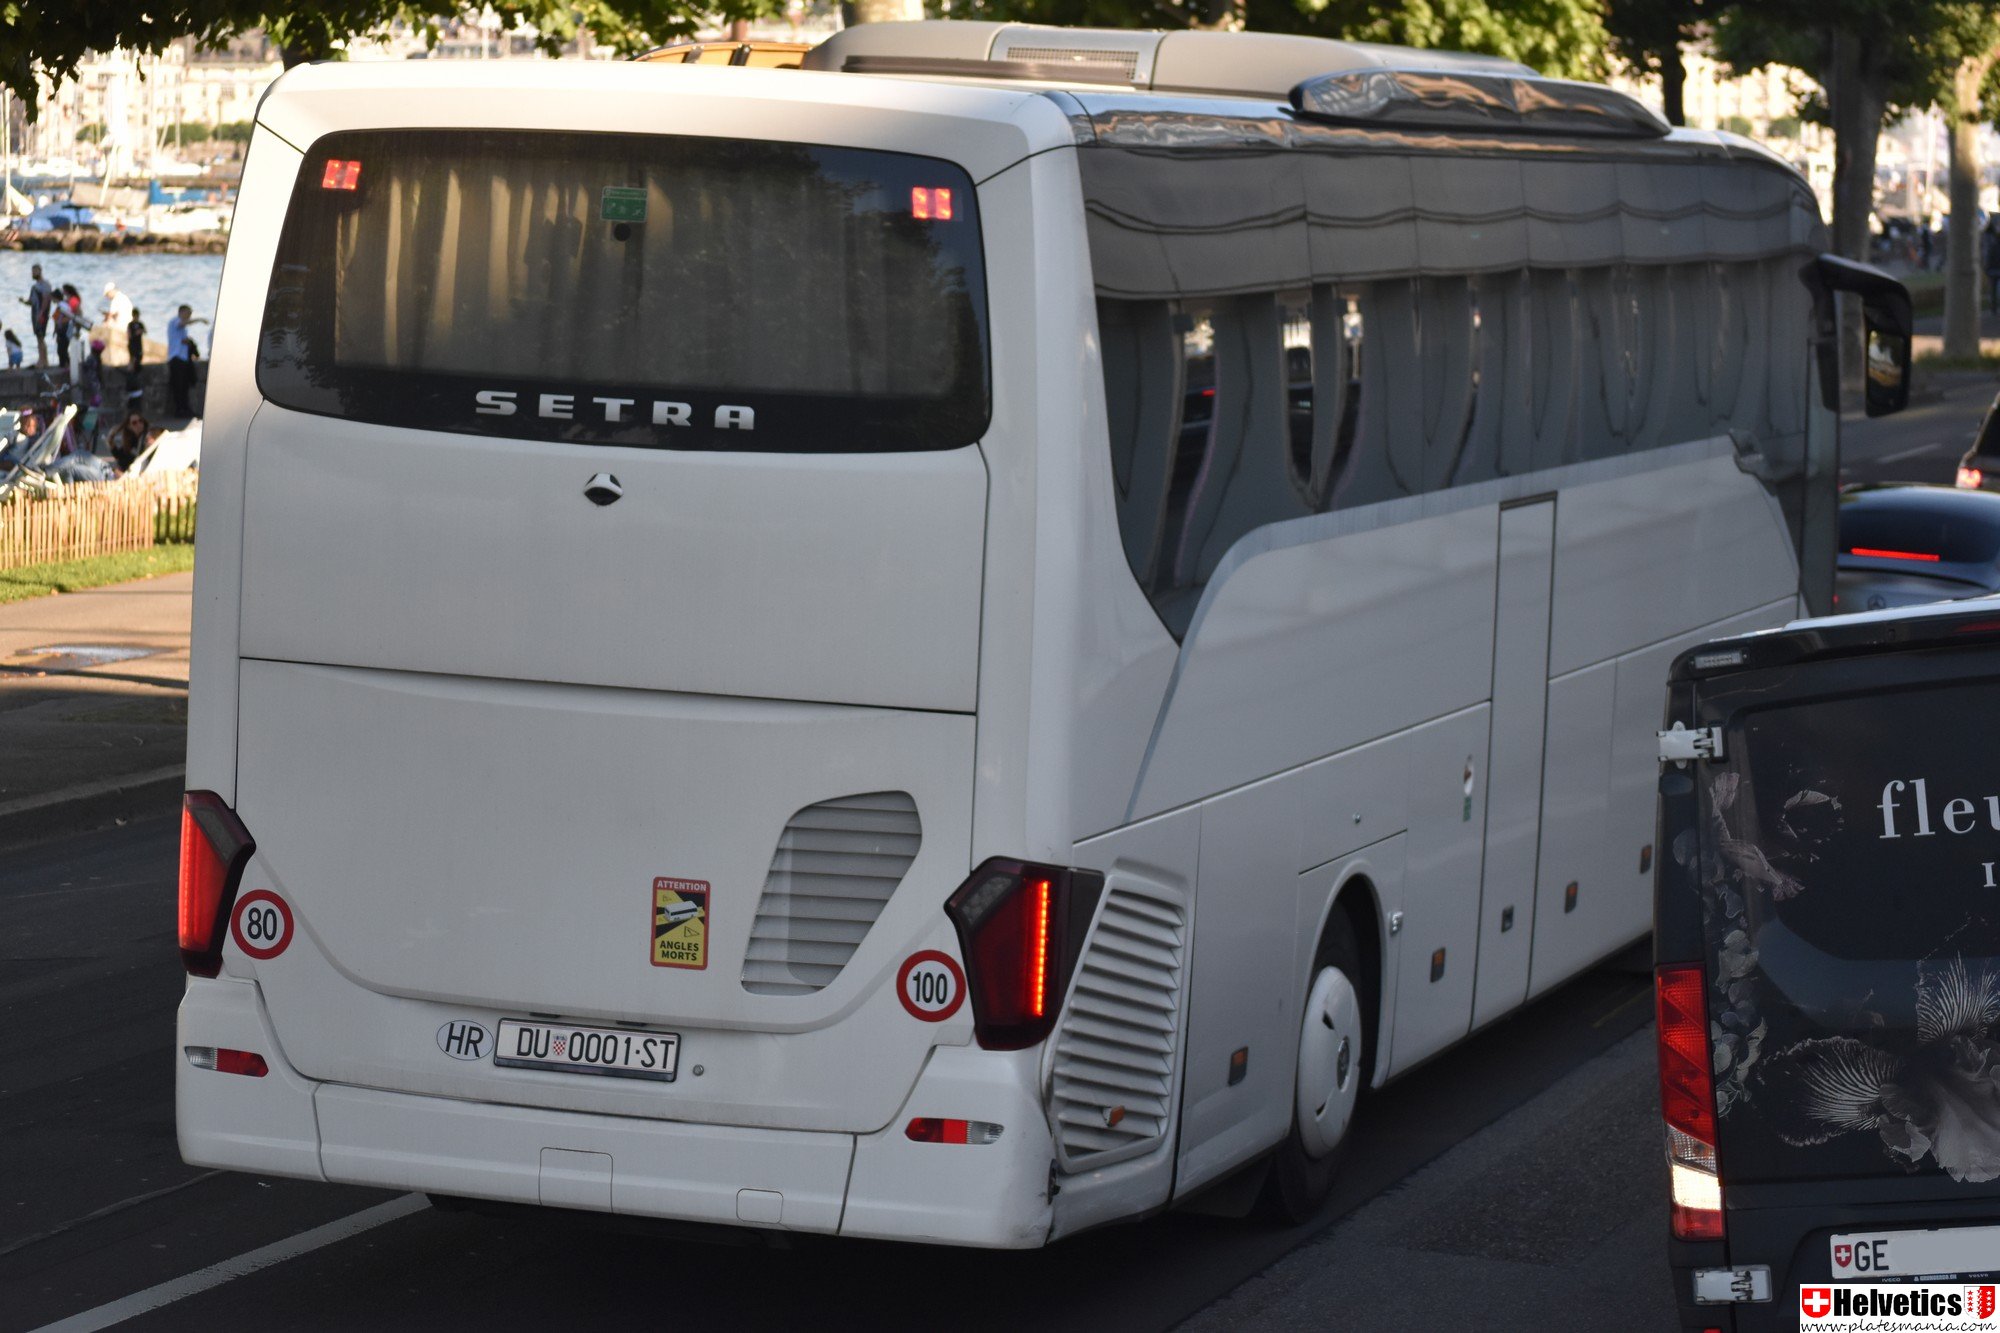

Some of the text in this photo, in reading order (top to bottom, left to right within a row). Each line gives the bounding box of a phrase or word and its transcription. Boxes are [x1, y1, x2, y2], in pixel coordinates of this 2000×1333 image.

[475, 390, 755, 431] SETRA
[657, 880, 707, 891] ATTENTION
[247, 907, 277, 941] 80
[660, 940, 699, 951] ANGLES
[661, 950, 697, 961] MORTS
[913, 971, 947, 1004] 100
[445, 1022, 484, 1057] HR
[516, 1027, 551, 1058] DU
[1854, 1240, 1889, 1271] GE
